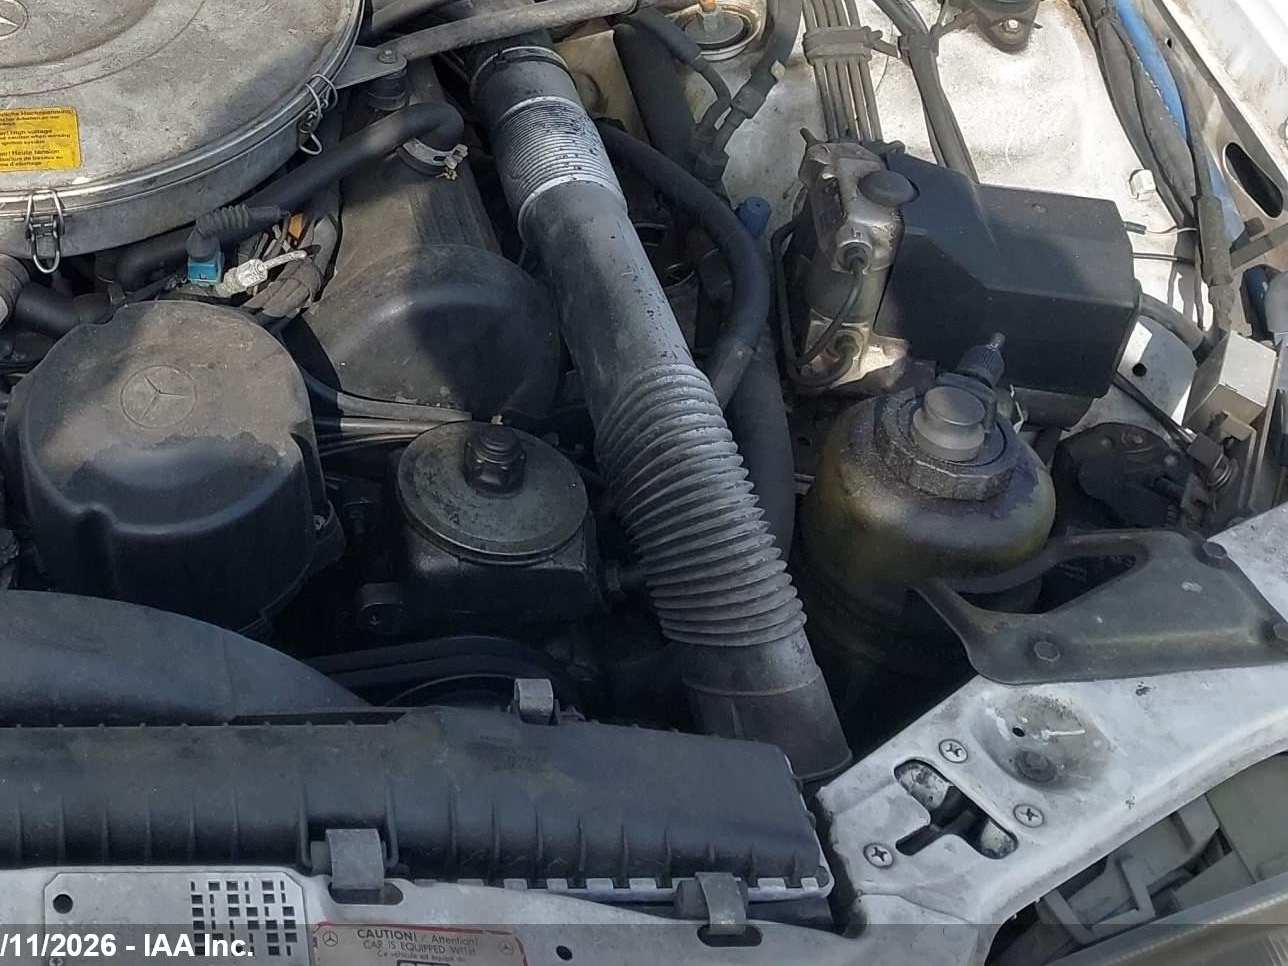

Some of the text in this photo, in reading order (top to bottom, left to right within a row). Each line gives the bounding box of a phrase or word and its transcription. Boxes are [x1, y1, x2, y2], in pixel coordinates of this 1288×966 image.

[356, 929, 417, 942] CAUTION!
[431, 934, 479, 947] Attention!
[363, 940, 384, 950] CAR
[387, 941, 396, 950] IS
[400, 942, 446, 955] EQUIPPED
